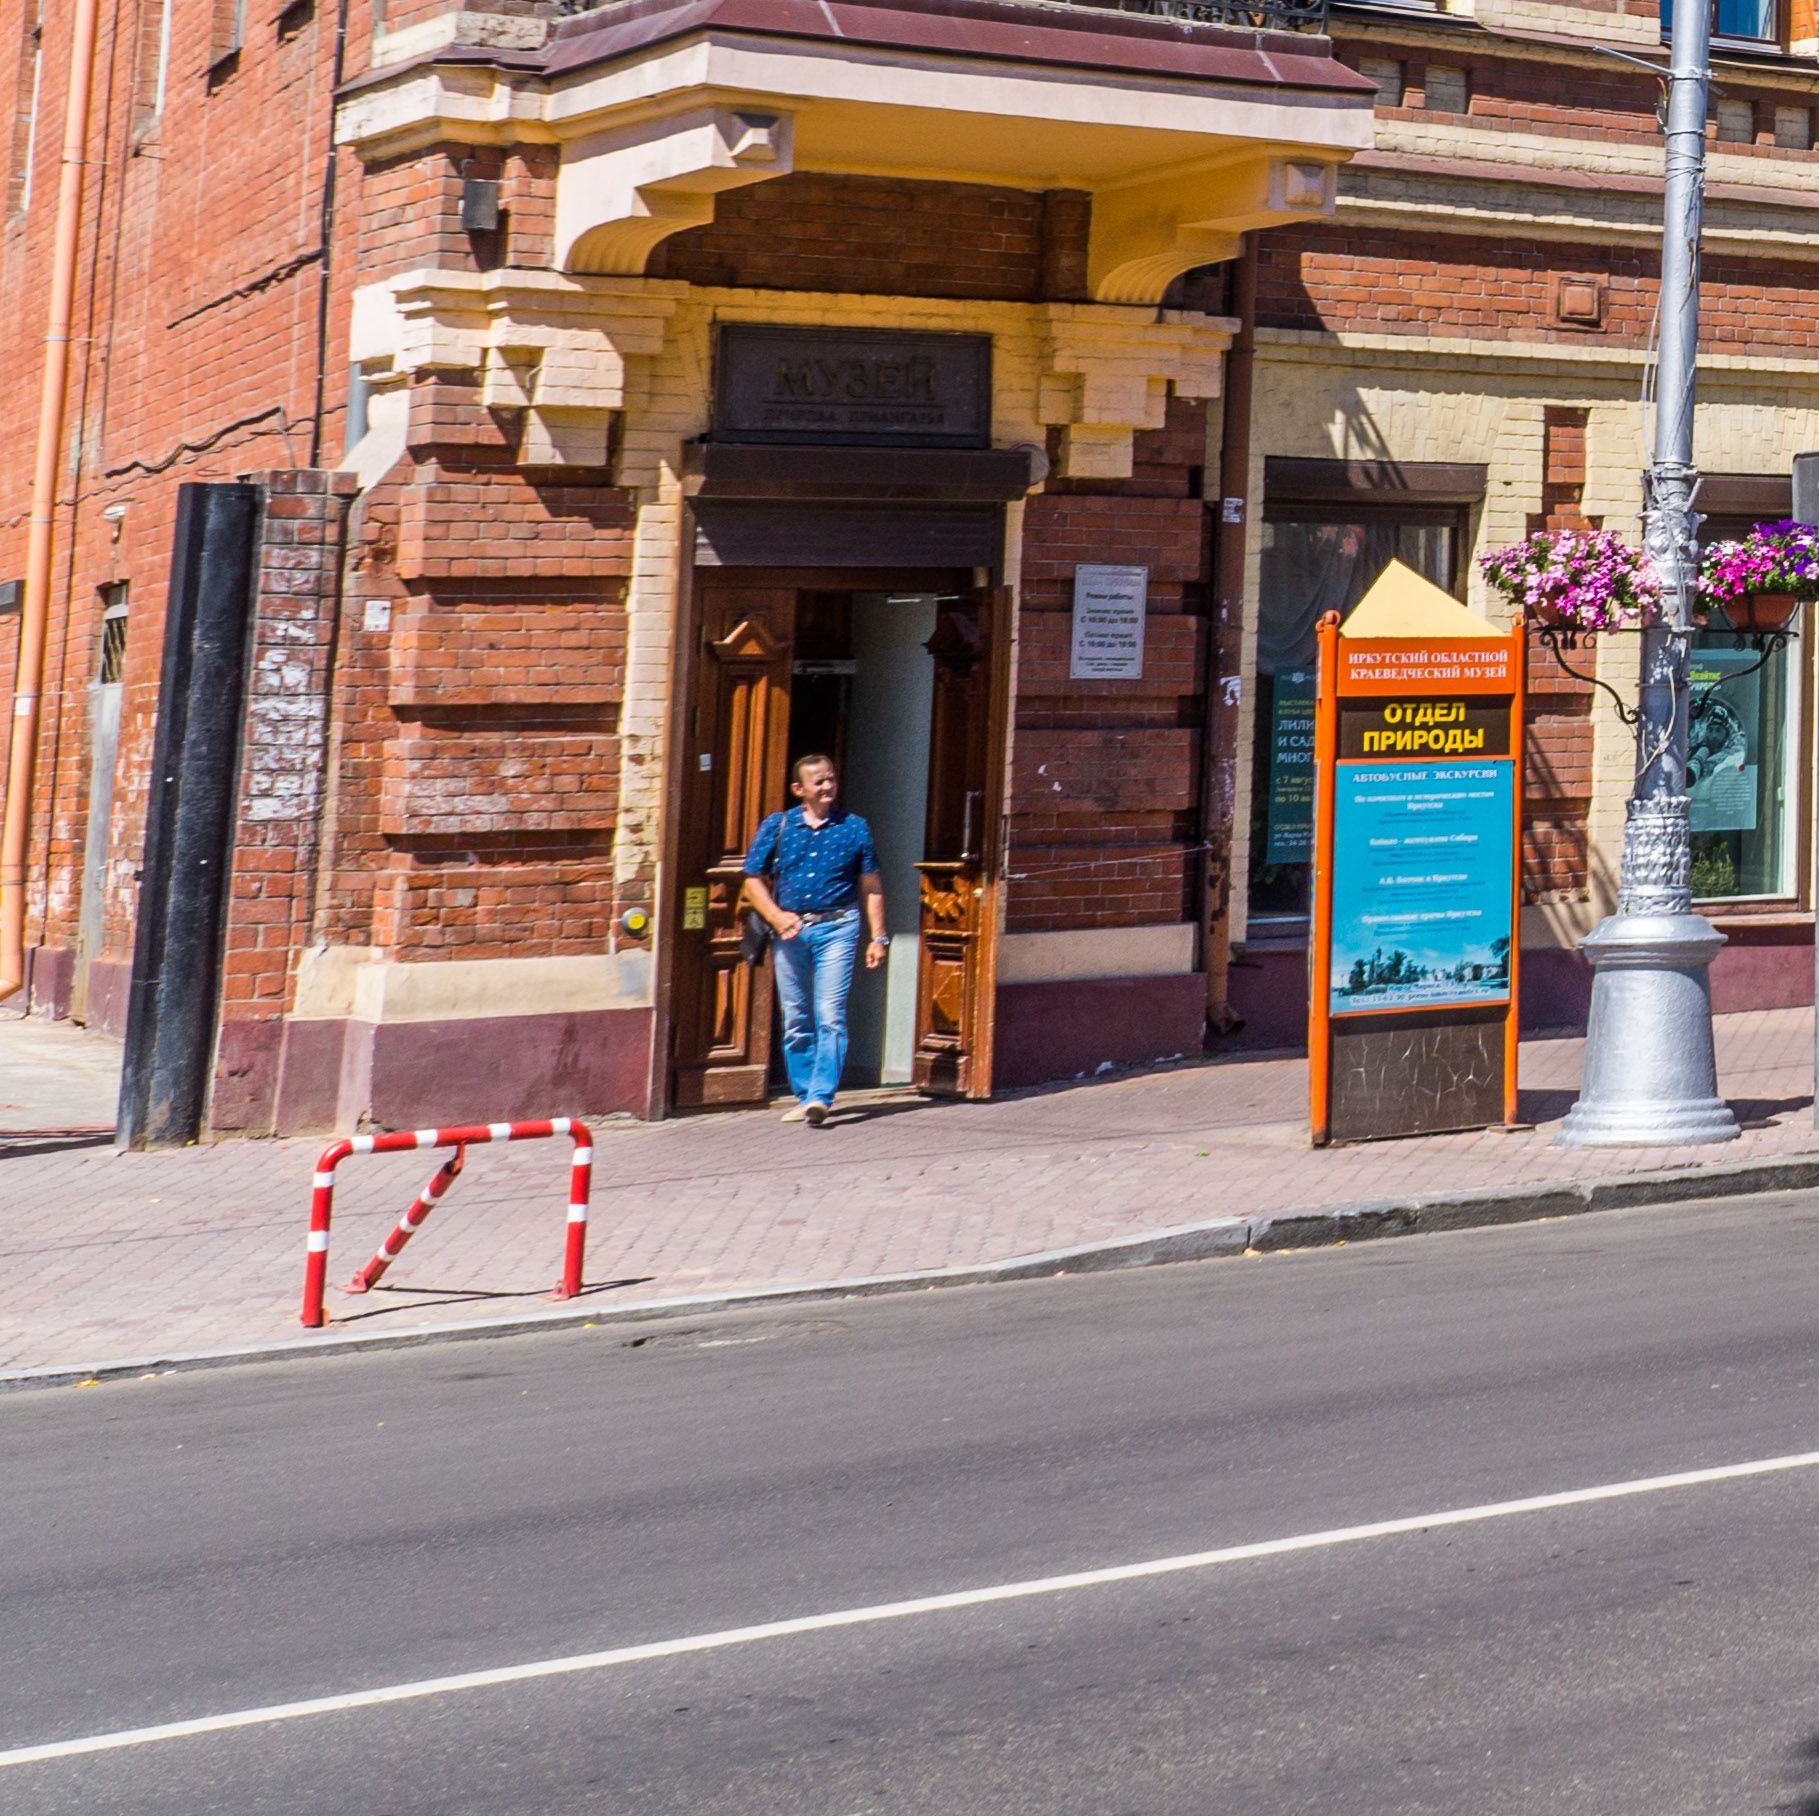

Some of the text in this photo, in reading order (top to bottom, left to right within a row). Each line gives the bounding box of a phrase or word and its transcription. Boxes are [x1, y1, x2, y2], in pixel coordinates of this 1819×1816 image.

[1349, 649, 1508, 665] ИРКУТСКИЙ ОБЛАСТНОЙ
[1350, 664, 1507, 680] КРАЕВЕДЧЕСКИЙ МУЗЕЙ
[1384, 702, 1466, 726] ОТДЕЛ
[1362, 728, 1485, 753] ПРИРОДЫ
[1353, 769, 1498, 783] АВТОБУСНЫЕ ЭКСКУРСИИ
